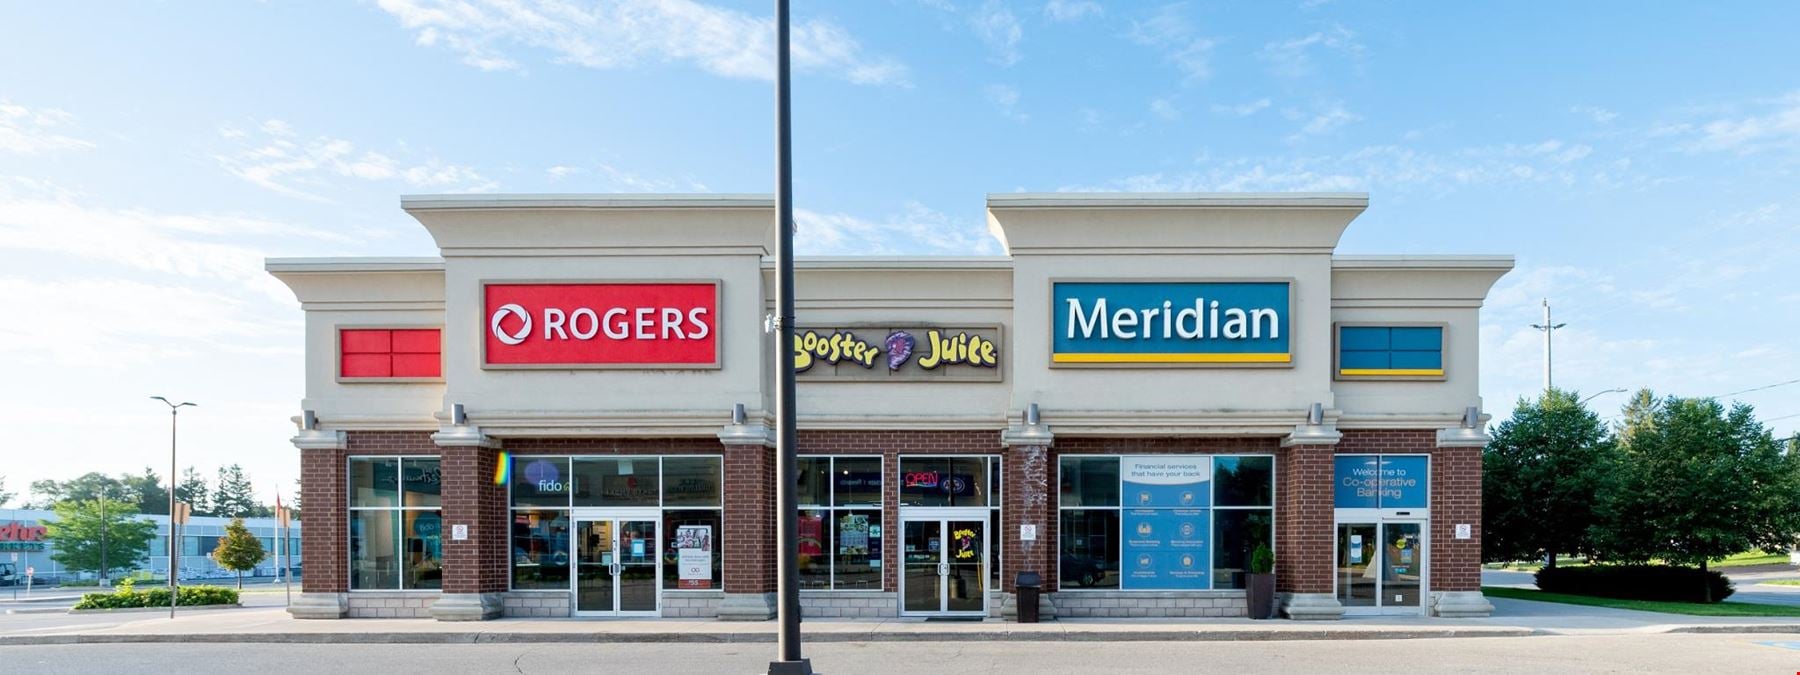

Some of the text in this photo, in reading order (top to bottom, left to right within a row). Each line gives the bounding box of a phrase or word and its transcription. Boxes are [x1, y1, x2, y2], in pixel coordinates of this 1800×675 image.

[544, 307, 709, 341] ROGERS
[1066, 297, 1279, 339] Meridian
[918, 329, 996, 368] Juice
[1352, 468, 1407, 476] Welcome to
[905, 473, 938, 485] OPEN
[1342, 477, 1416, 489] Co-operative
[538, 479, 562, 492] fido
[1356, 488, 1402, 499] Banking
